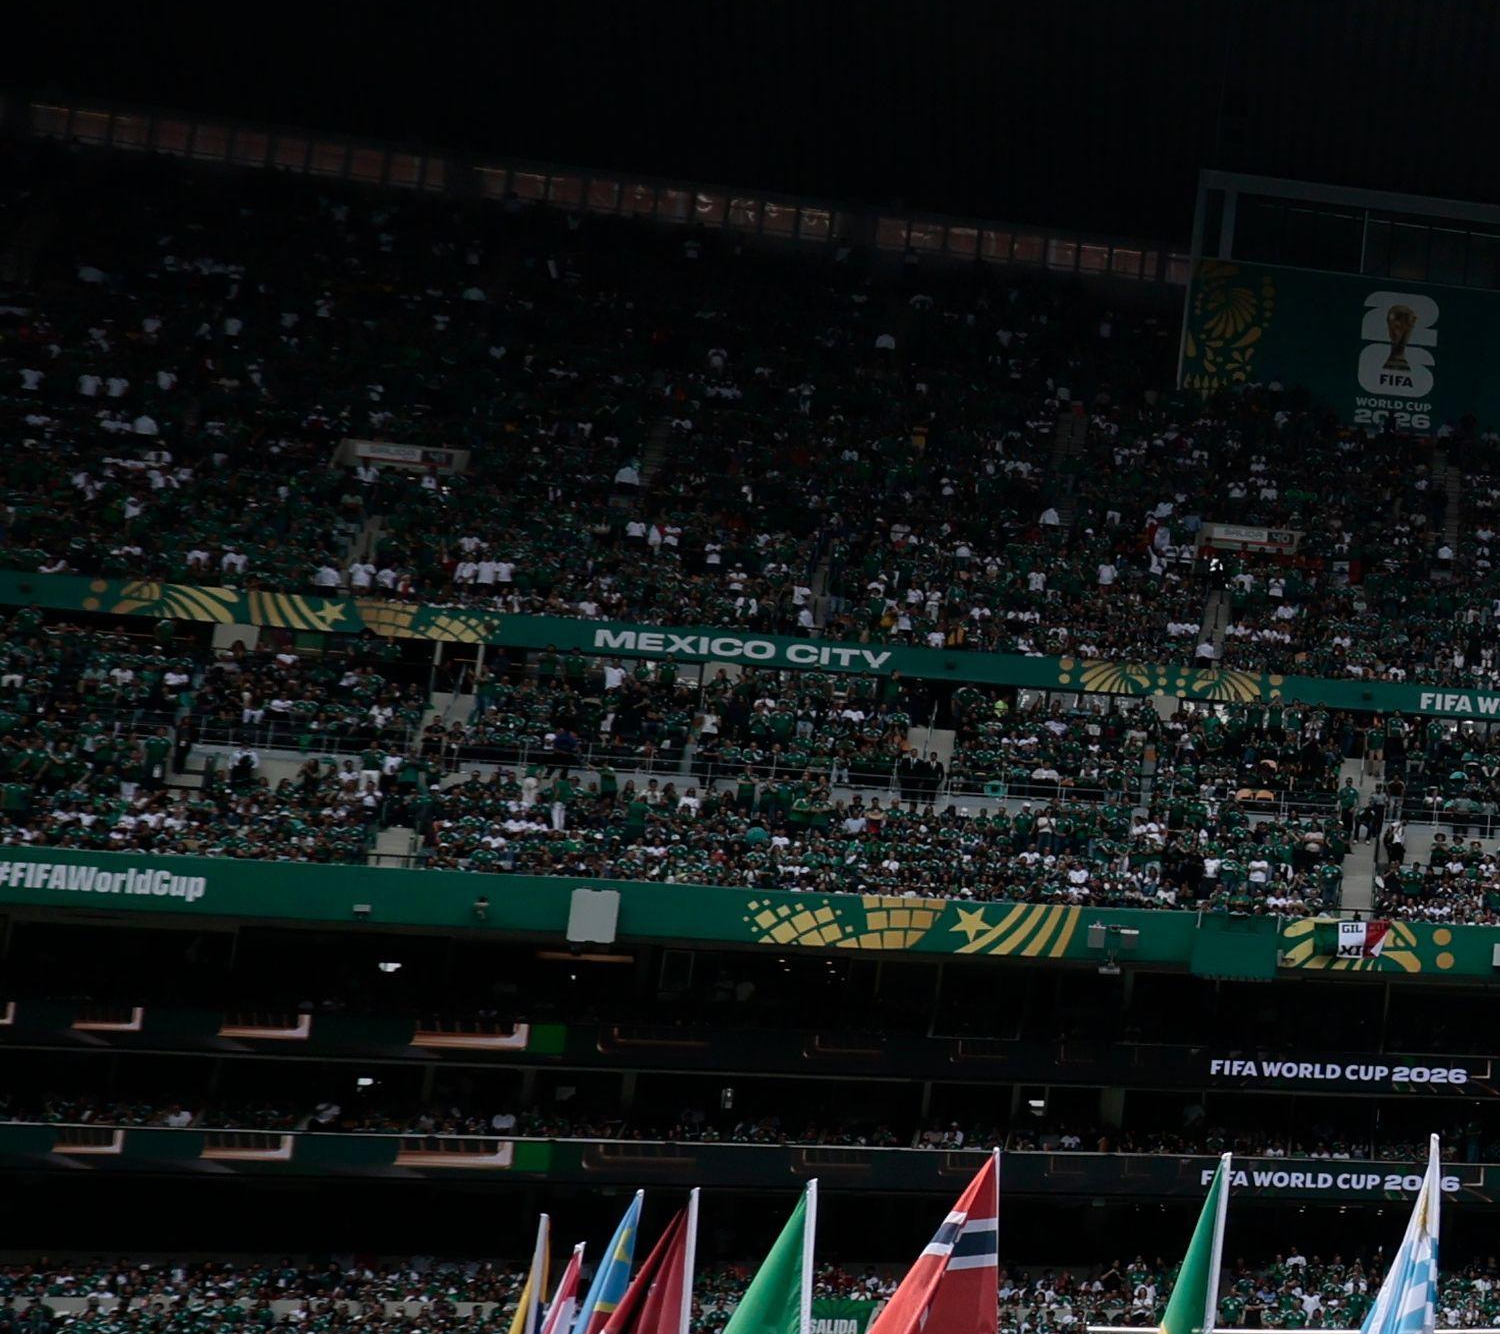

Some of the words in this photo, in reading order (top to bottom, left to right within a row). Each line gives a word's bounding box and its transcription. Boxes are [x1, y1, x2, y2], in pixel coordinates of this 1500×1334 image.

[1380, 374, 1413, 388] FIFA
[1356, 396, 1404, 411] WORLD
[1406, 401, 1432, 413] CUP
[1354, 408, 1431, 429] 2026
[594, 629, 776, 659] MEXICO
[786, 644, 891, 668] CITY
[1420, 692, 1472, 713] FIFA
[1342, 924, 1363, 933] GIL
[1210, 1059, 1257, 1077] FIFA
[1261, 1061, 1341, 1080] WORLD
[1345, 1065, 1389, 1081] CUP
[1391, 1067, 1468, 1084] 2026
[1200, 1170, 1249, 1188] FFA
[1252, 1171, 1333, 1189] WORLD
[1336, 1173, 1380, 1191] CUP
[1383, 1175, 1461, 1192] 206
[809, 1319, 858, 1334] SALIDA
